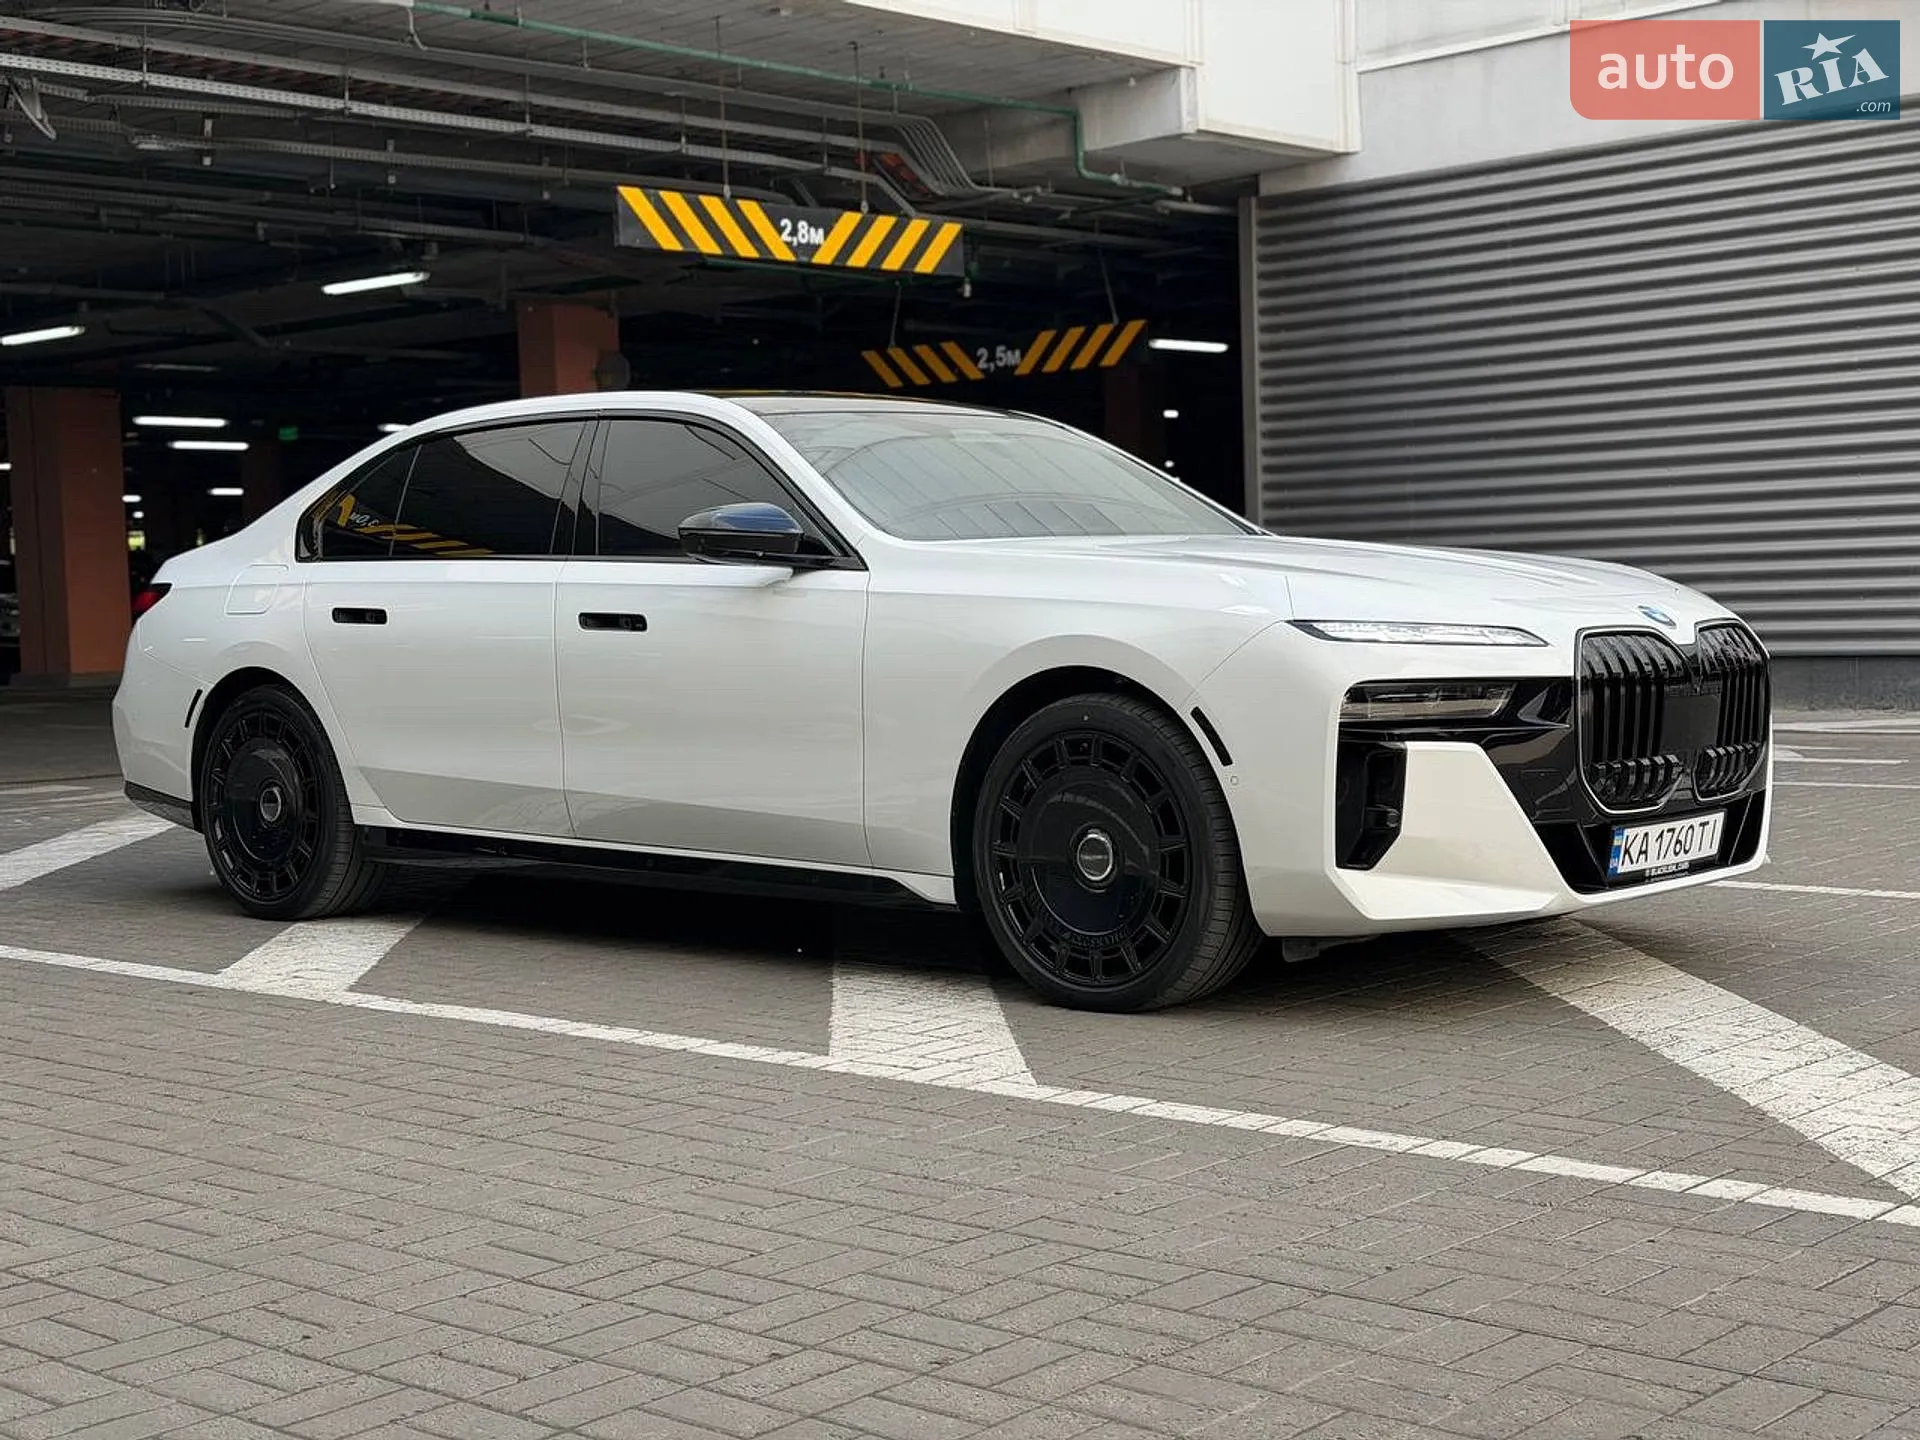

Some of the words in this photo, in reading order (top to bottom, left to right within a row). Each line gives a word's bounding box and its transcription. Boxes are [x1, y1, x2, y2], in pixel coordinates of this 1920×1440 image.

[1621, 831, 1650, 866] KA
[1655, 823, 1695, 860] 1760
[1698, 819, 1717, 852] TI
